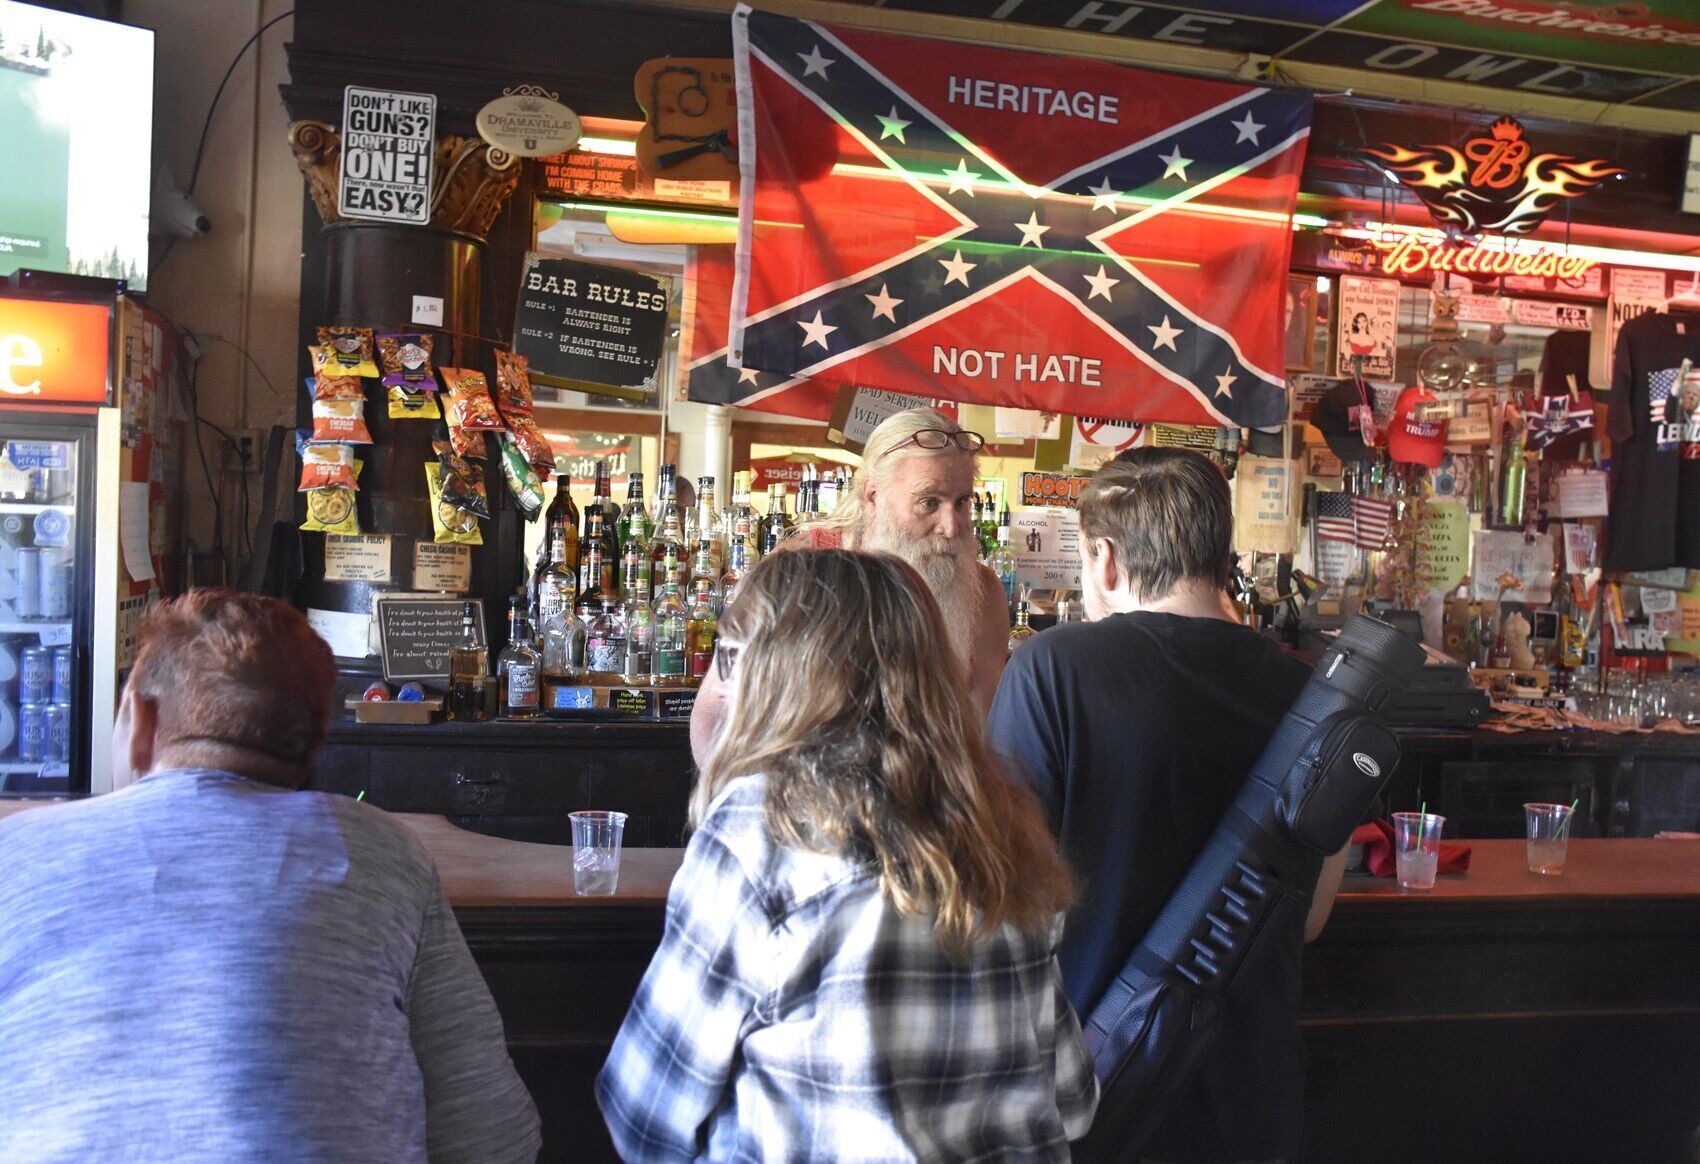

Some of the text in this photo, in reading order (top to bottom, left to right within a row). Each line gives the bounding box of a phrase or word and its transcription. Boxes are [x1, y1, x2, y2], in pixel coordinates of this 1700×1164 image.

[1411, 0, 1700, 46] Budweis
[350, 94, 430, 115] DON'T LIKE
[948, 75, 1120, 124] HERITAGE
[350, 109, 430, 138] GUNS?
[348, 133, 428, 155] DON'T BUY
[345, 147, 428, 185] ONE!
[568, 154, 596, 168] ABOUT
[556, 166, 596, 180] COMING
[597, 168, 624, 180] HOME
[547, 177, 572, 190] WITH
[574, 179, 590, 191] THE
[345, 186, 424, 216] EASY?
[1370, 232, 1600, 280] Budweiser
[527, 272, 666, 313] BAR RULES
[525, 300, 547, 311] RULE
[1613, 303, 1644, 321] NOT
[565, 307, 632, 326] BARTENDER IS
[521, 327, 543, 338] RULE
[562, 317, 632, 336] ALWAYS RIGHT
[560, 334, 638, 355] IF BARTENDER IS
[598, 351, 616, 361] SEE
[617, 354, 642, 366] RULE
[932, 345, 1102, 387] NOT HATE
[854, 407, 889, 426] WELC
[1405, 423, 1440, 438] TRUMP
[1024, 473, 1090, 498] HOOT
[1018, 520, 1049, 528] ALCOHOL
[366, 535, 387, 545] POLICY
[419, 544, 437, 554] CHECK
[434, 608, 452, 617] health
[435, 618, 453, 627] health
[435, 628, 453, 637] health
